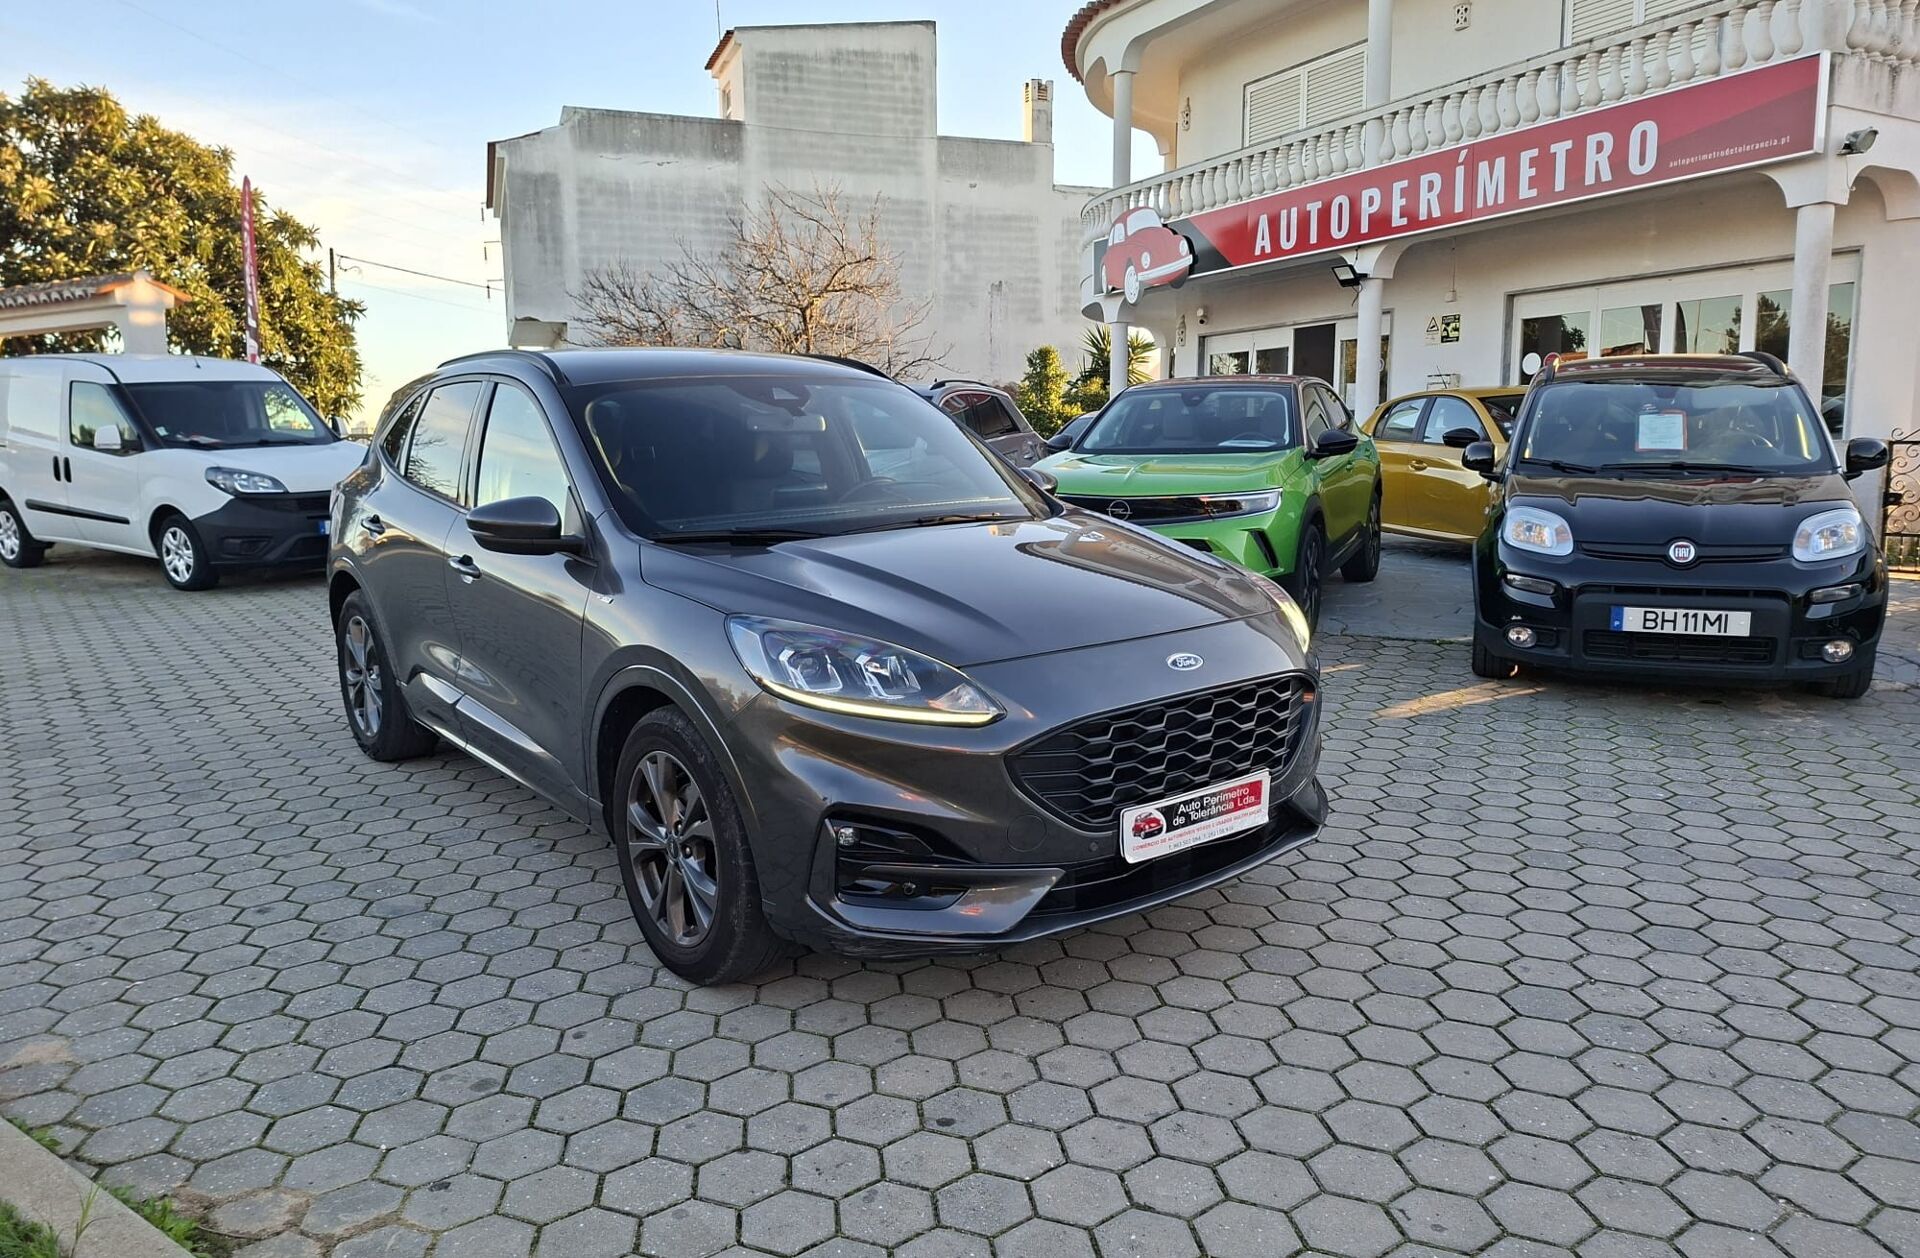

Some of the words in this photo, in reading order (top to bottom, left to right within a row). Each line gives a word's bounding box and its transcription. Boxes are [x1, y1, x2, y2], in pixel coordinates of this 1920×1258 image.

[1669, 135, 1790, 168] autoperimetrodetolerancia.pt
[1254, 120, 1658, 256] AUTOPERÍMETRO
[1172, 815, 1186, 826] de
[1189, 801, 1234, 821] Tolerância
[1178, 801, 1200, 814] Auto
